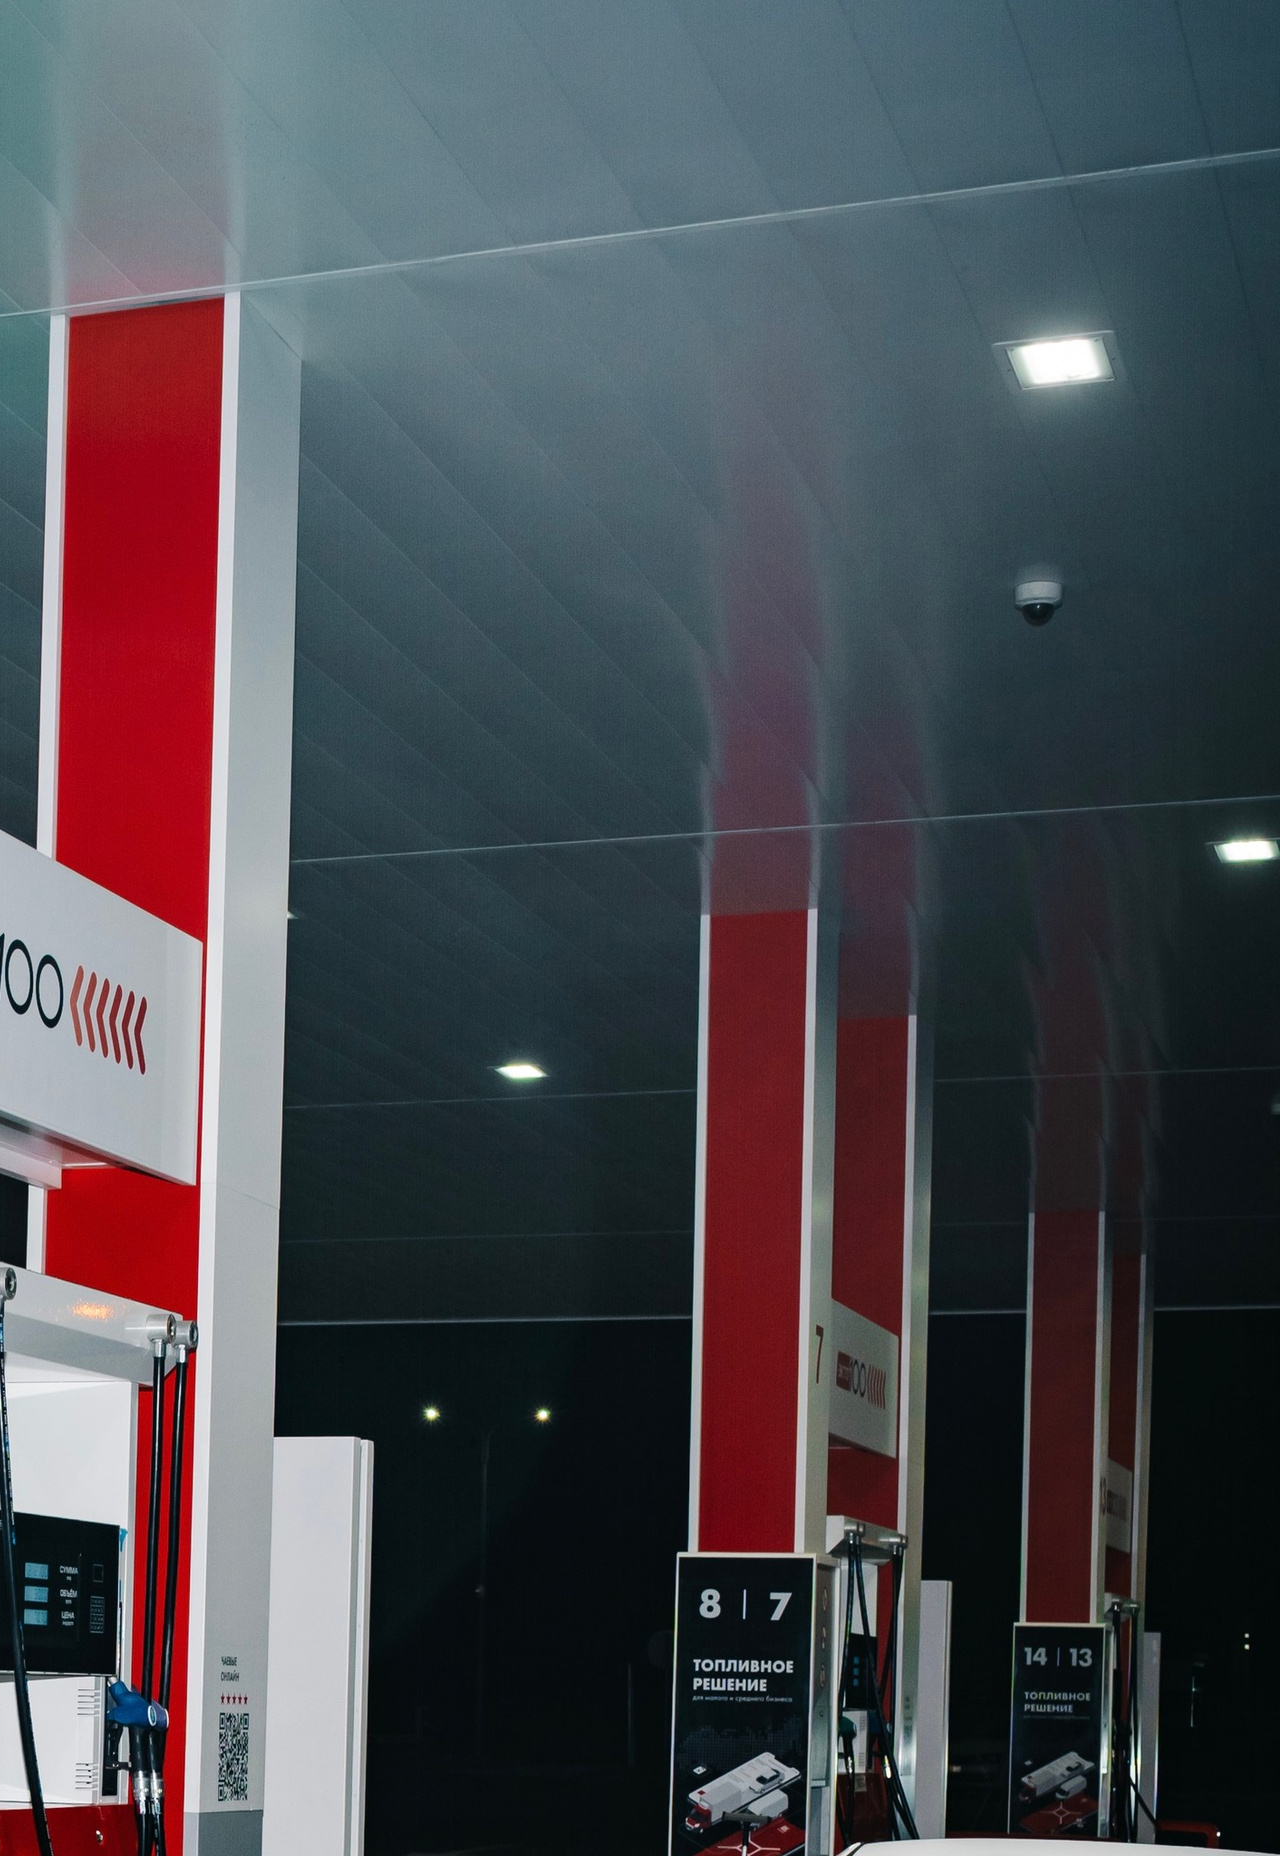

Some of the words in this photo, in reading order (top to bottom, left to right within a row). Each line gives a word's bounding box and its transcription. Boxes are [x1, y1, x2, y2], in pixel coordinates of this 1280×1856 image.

[816, 1324, 824, 1384] 7
[699, 1588, 721, 1619] 8
[769, 1591, 793, 1621] 7
[1024, 1646, 1048, 1666] 14
[1069, 1647, 1093, 1668] 13
[693, 1658, 795, 1674] ТОПЛИВНОЕ
[693, 1677, 768, 1692] РЕШЕНИЕ
[1024, 1691, 1091, 1702] ТОПЛИВНОЕ
[1023, 1703, 1074, 1714] РЕШЕНИЕ
